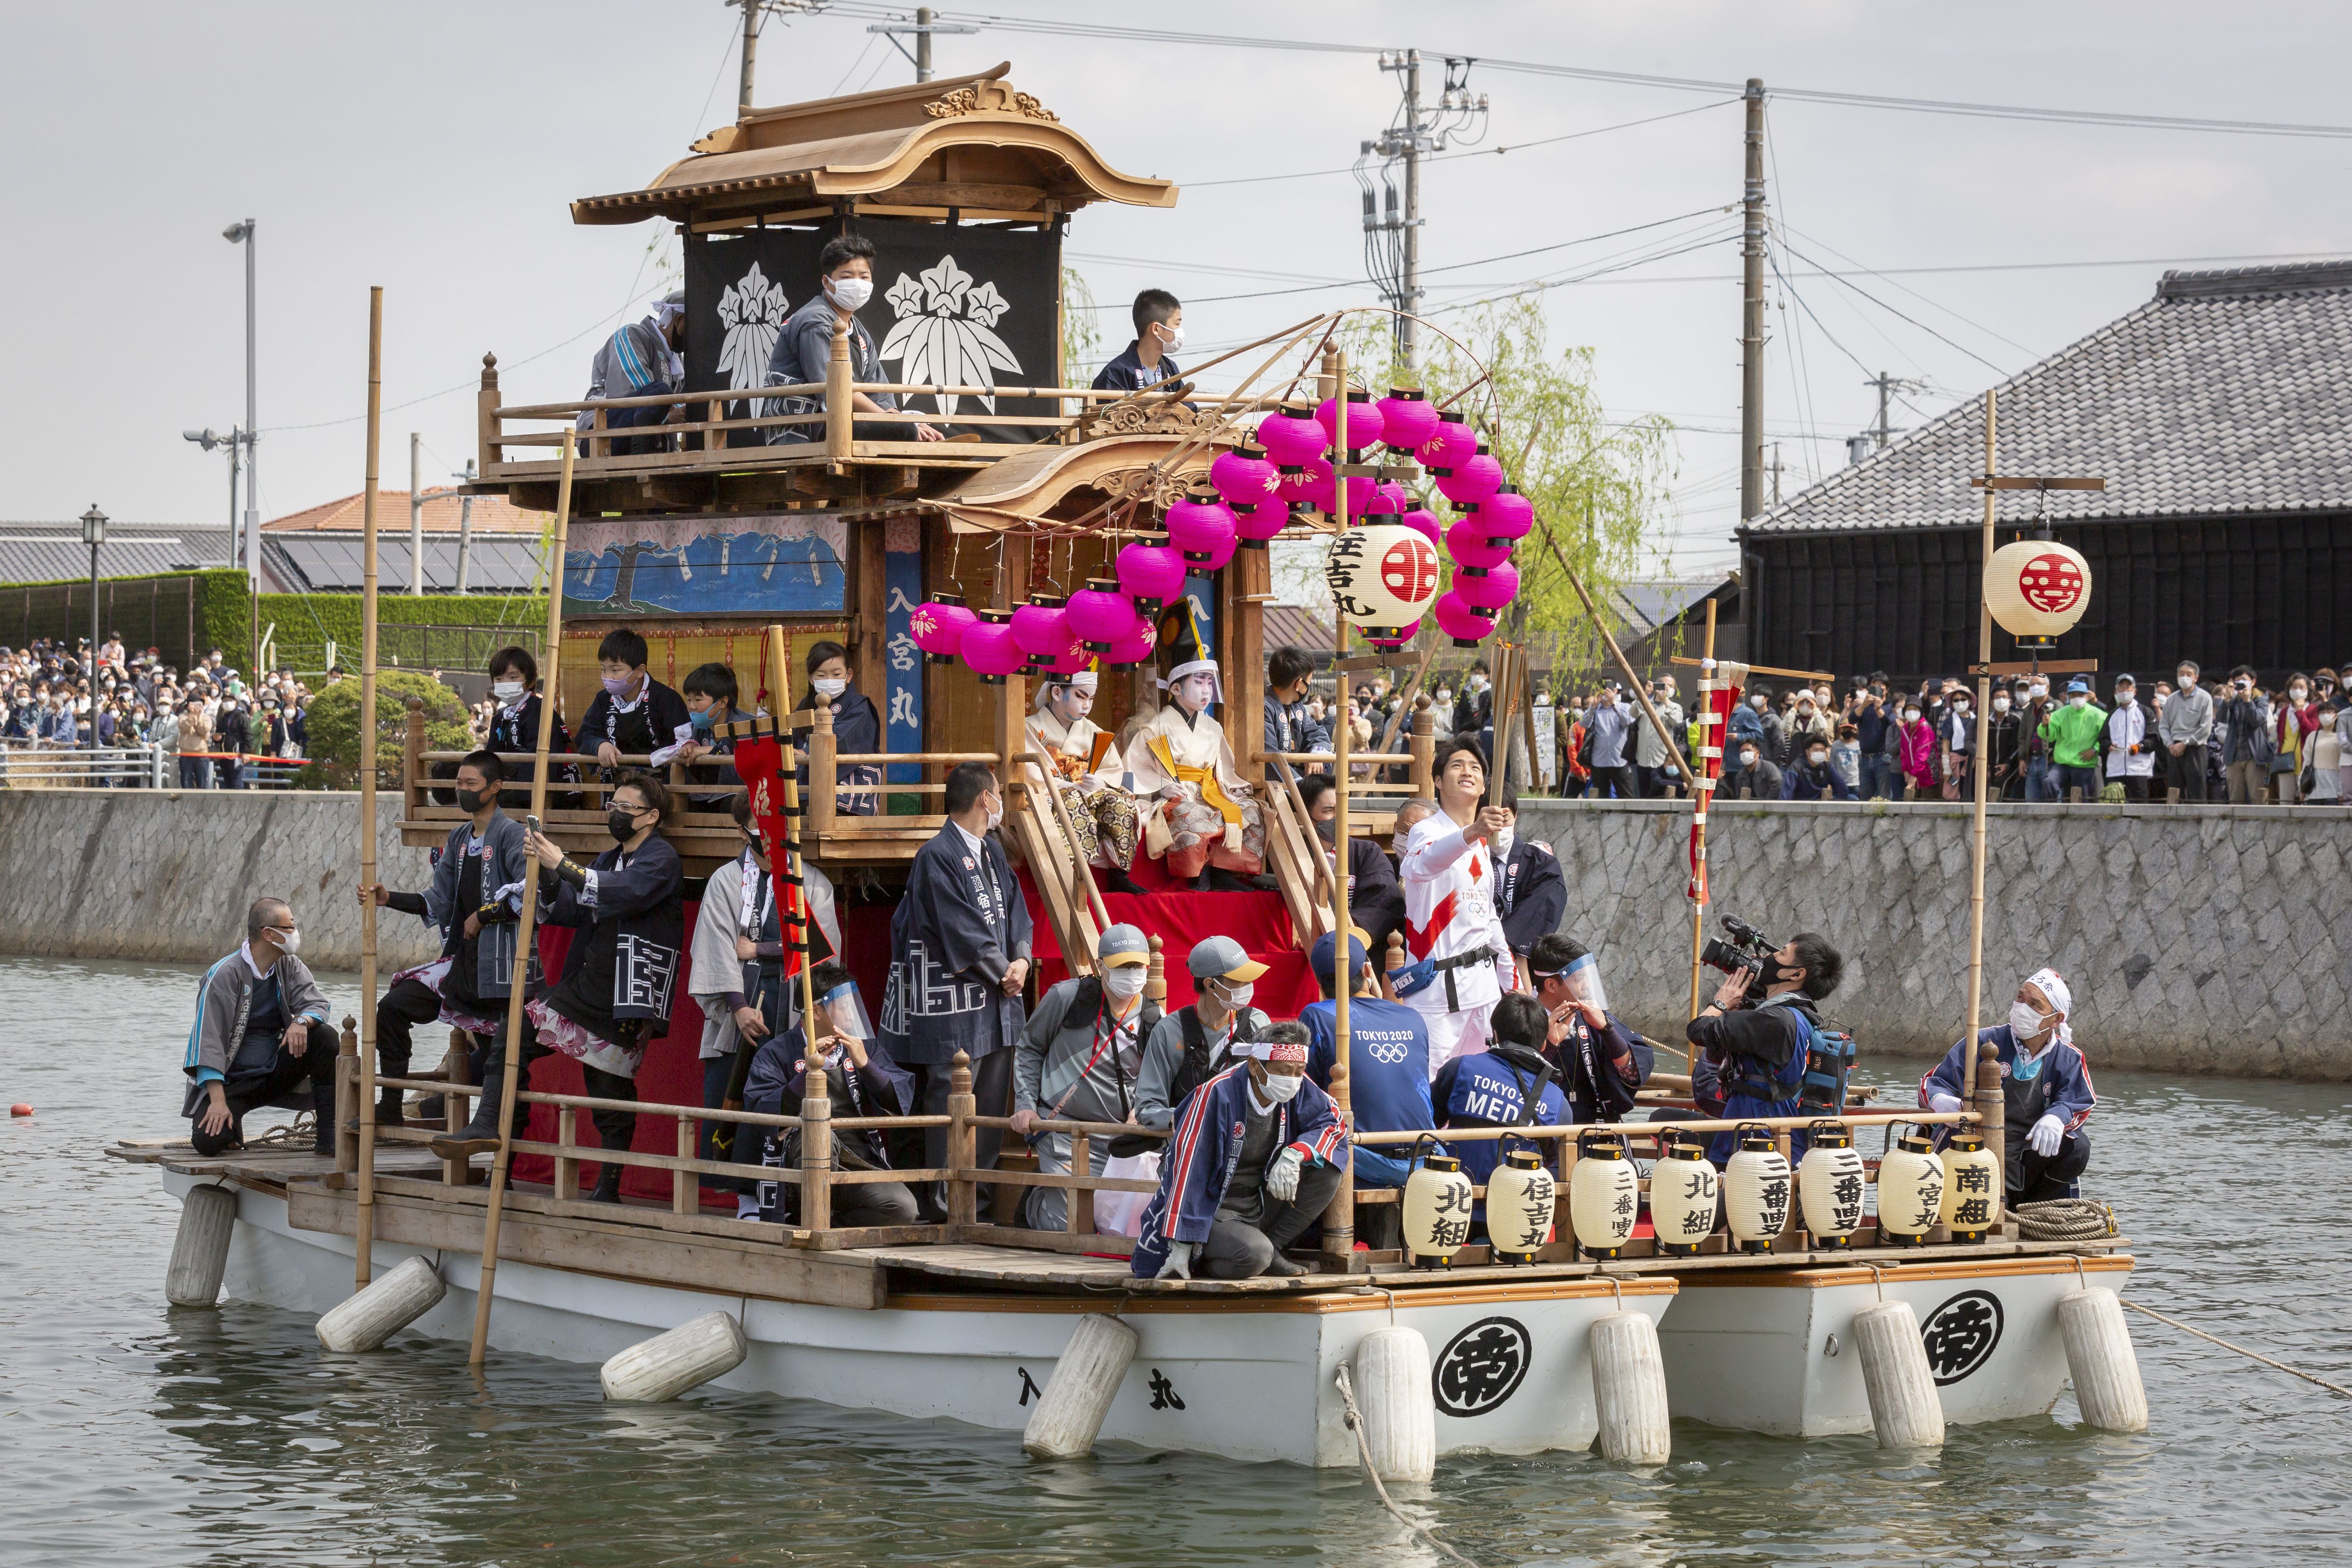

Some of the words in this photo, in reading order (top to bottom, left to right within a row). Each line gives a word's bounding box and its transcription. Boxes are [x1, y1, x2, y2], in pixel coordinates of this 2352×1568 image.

[1324, 532, 1376, 616] 住吉丸
[887, 587, 918, 728] 入宮丸
[1355, 1031, 1387, 1041] TOKYO
[1389, 1030, 1413, 1040] 2020
[1465, 1090, 1535, 1127] MED
[1474, 1074, 1517, 1100] TOKYO
[1517, 1093, 1547, 1115] 220
[1427, 1182, 1472, 1248] 北組
[1516, 1177, 1553, 1248] 住吉丸
[1681, 1171, 1716, 1235] 北組
[1754, 1158, 1790, 1235] 三番叟
[1828, 1153, 1864, 1230] 三番叟
[1908, 1159, 1944, 1228] 入宮丸
[1953, 1164, 1991, 1225] 南組
